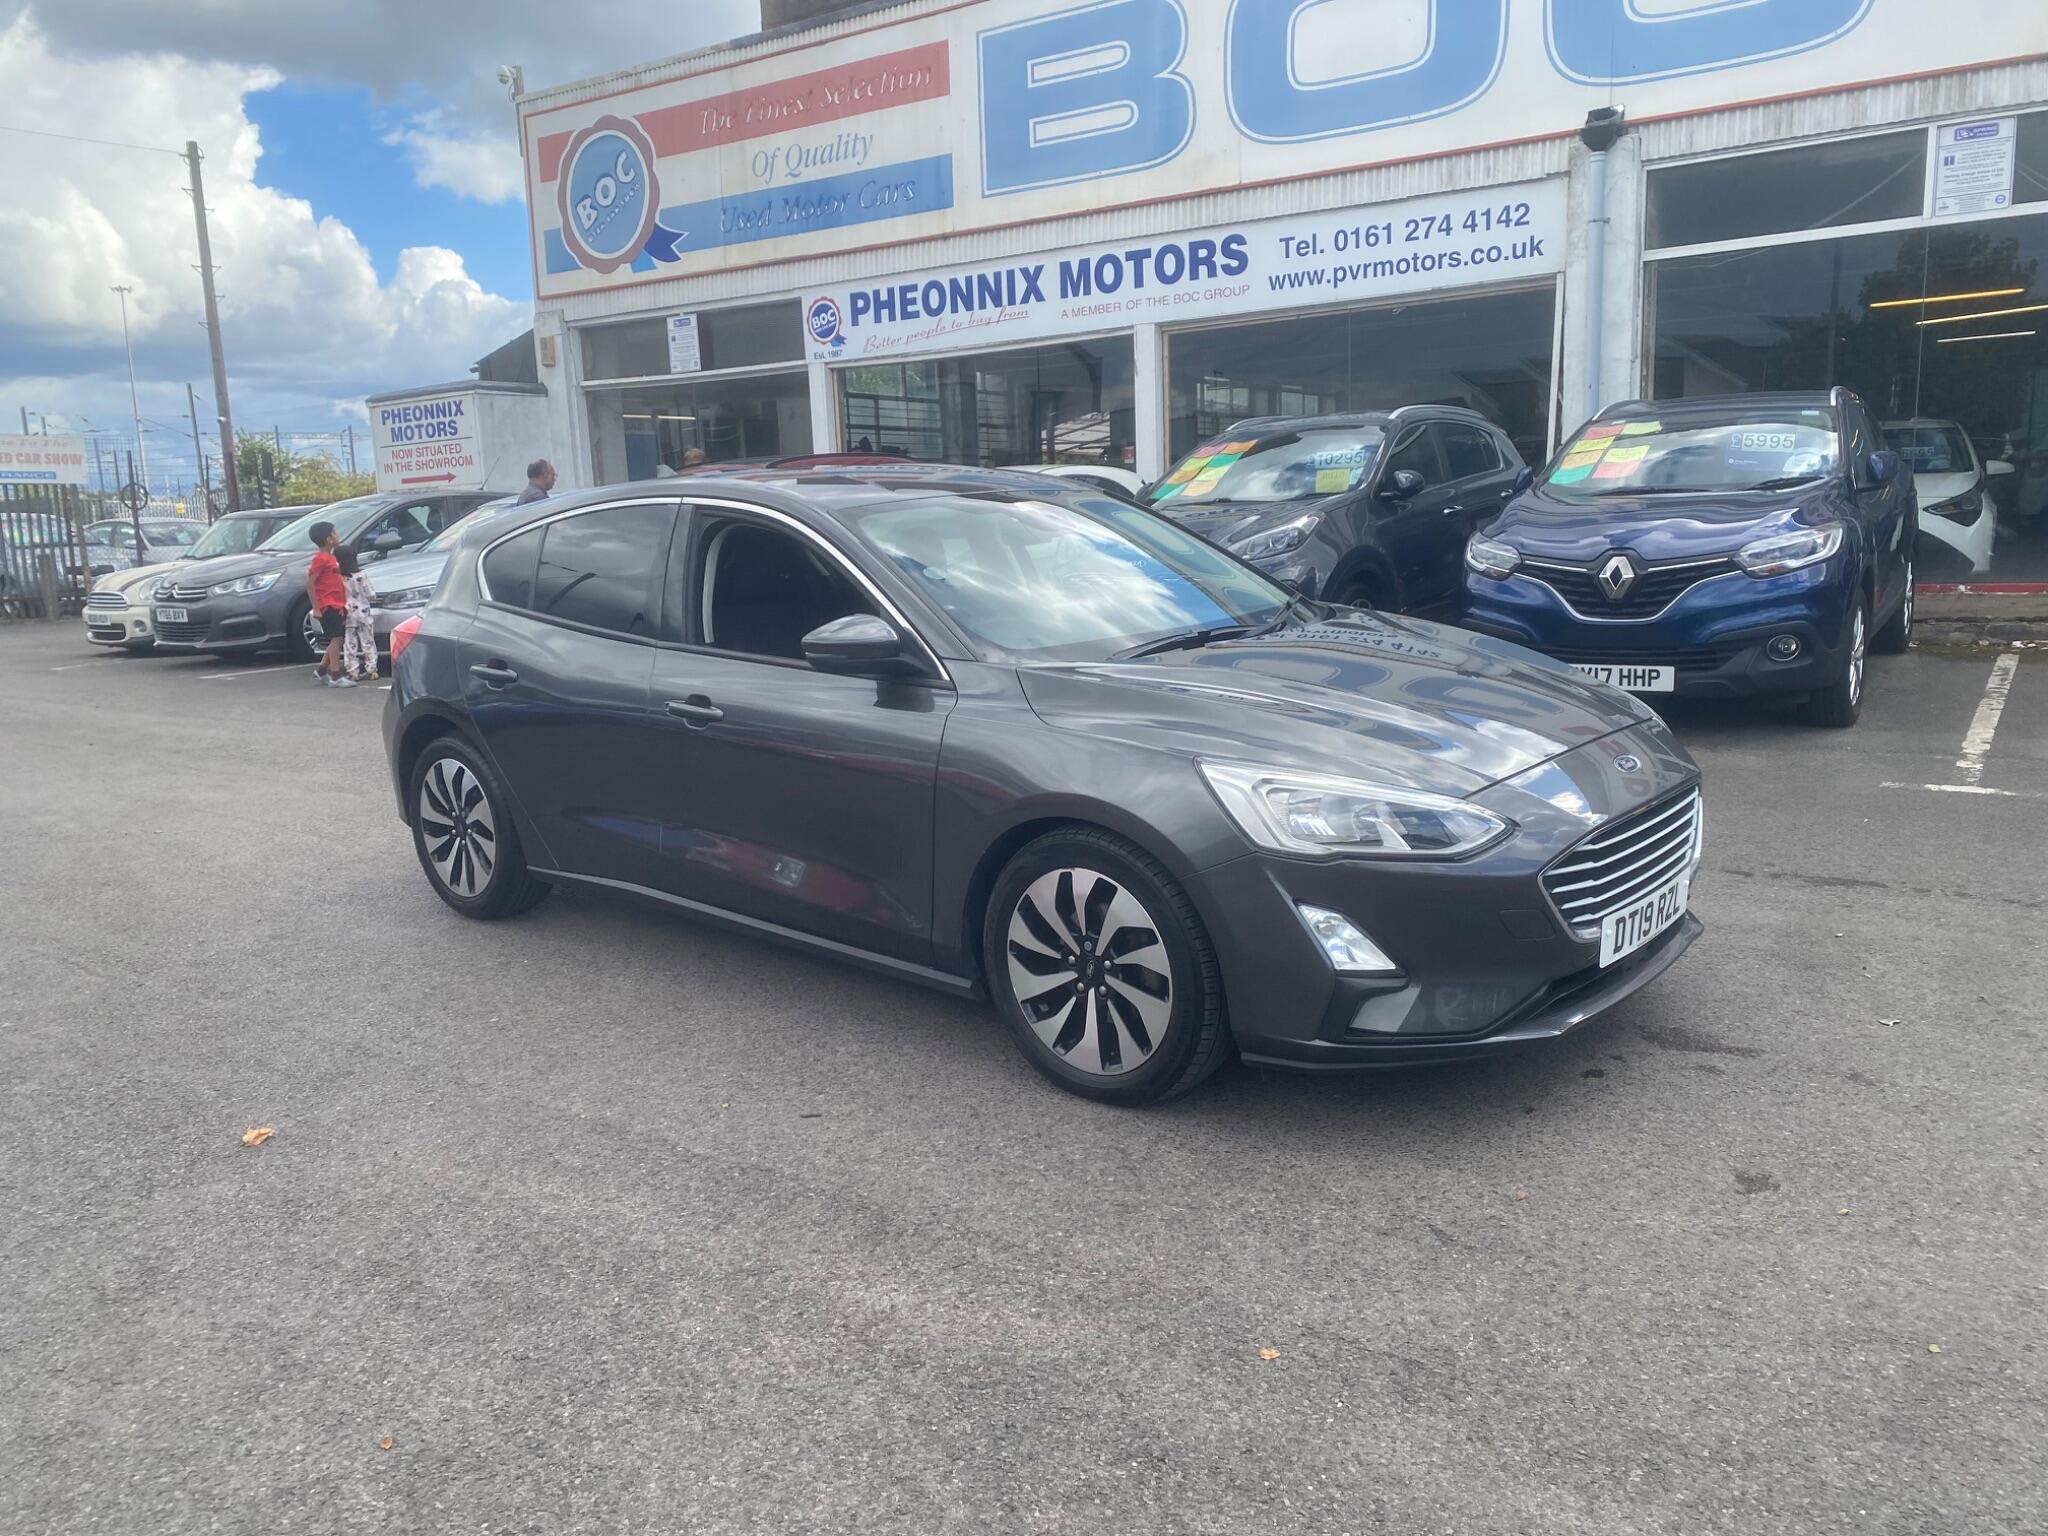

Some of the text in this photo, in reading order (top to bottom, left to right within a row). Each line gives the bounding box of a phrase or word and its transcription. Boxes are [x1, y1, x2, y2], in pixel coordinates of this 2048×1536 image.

[699, 107, 734, 135] The
[820, 66, 932, 108] Selection
[752, 132, 874, 184] Of Quality
[576, 150, 636, 230] BOC
[720, 179, 917, 234] Used Motor Cars
[1279, 203, 1531, 259] Tel. 0161 274 4142
[849, 233, 1249, 327] PHEONNIX MOTORS
[1268, 235, 1545, 291] www.pvrmotors.co.uk
[812, 309, 836, 329] BOC
[1061, 285, 1251, 319] A MEMBER OF THE BOC GROUP
[905, 317, 947, 345] people
[951, 318, 963, 330] to
[968, 311, 992, 327] buy
[996, 304, 1029, 324] from
[381, 400, 464, 425] PHEONNIX
[391, 420, 458, 442] MOTORS
[16, 452, 41, 465] CAR
[44, 452, 84, 465] SHOW
[384, 455, 473, 474] IN THE SHOWROOM
[391, 443, 462, 460] NOW SITUATED
[1619, 668, 1661, 687] HHP
[1613, 882, 1680, 955] DT19 RZL
